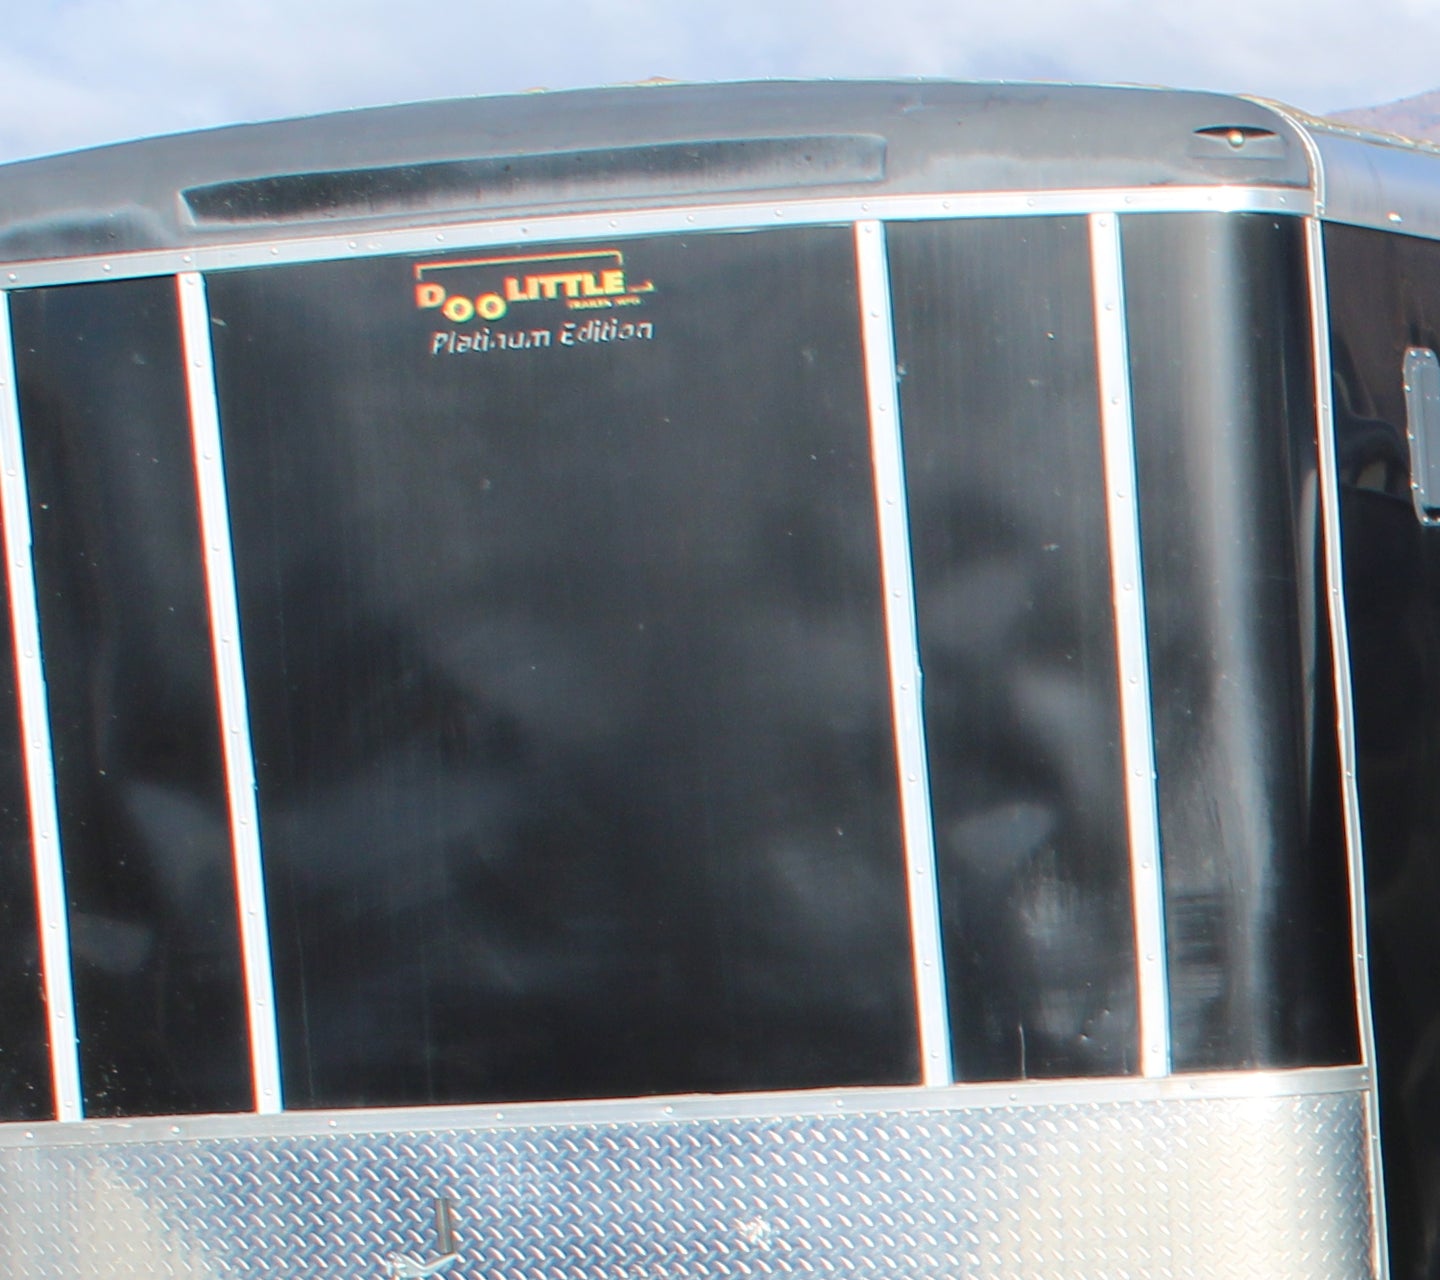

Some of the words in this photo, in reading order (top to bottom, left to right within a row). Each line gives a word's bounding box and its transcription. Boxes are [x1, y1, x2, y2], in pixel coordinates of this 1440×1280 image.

[415, 269, 627, 323] DOOLITTLE
[431, 328, 551, 355] Platinum
[560, 318, 654, 348] Edition
